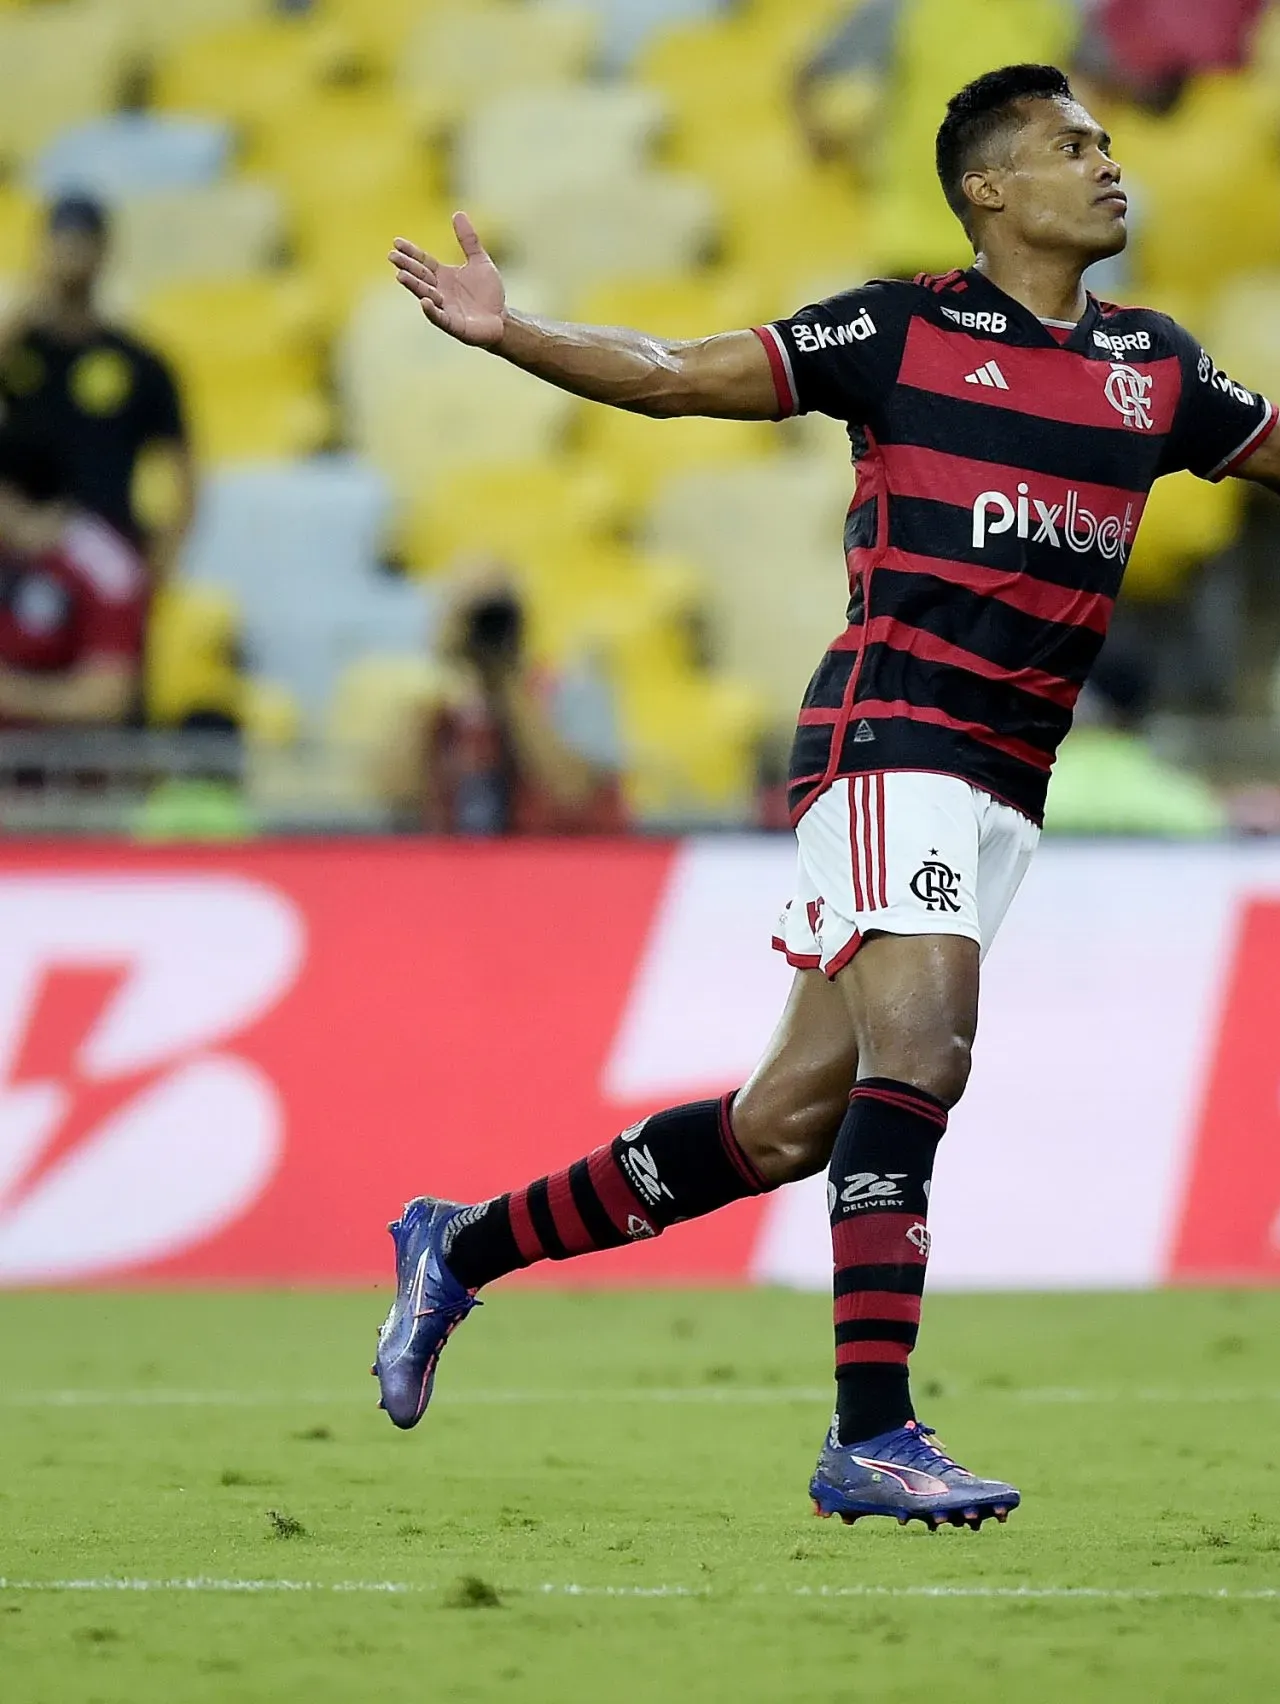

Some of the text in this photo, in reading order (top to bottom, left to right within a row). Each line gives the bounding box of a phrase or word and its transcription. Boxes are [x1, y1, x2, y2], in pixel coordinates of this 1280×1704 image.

[814, 307, 877, 349] kwai
[961, 311, 1008, 334] BRB
[1109, 331, 1151, 351] BRB
[972, 482, 1133, 565] pixbet
[842, 1200, 905, 1214] DELIVERY
